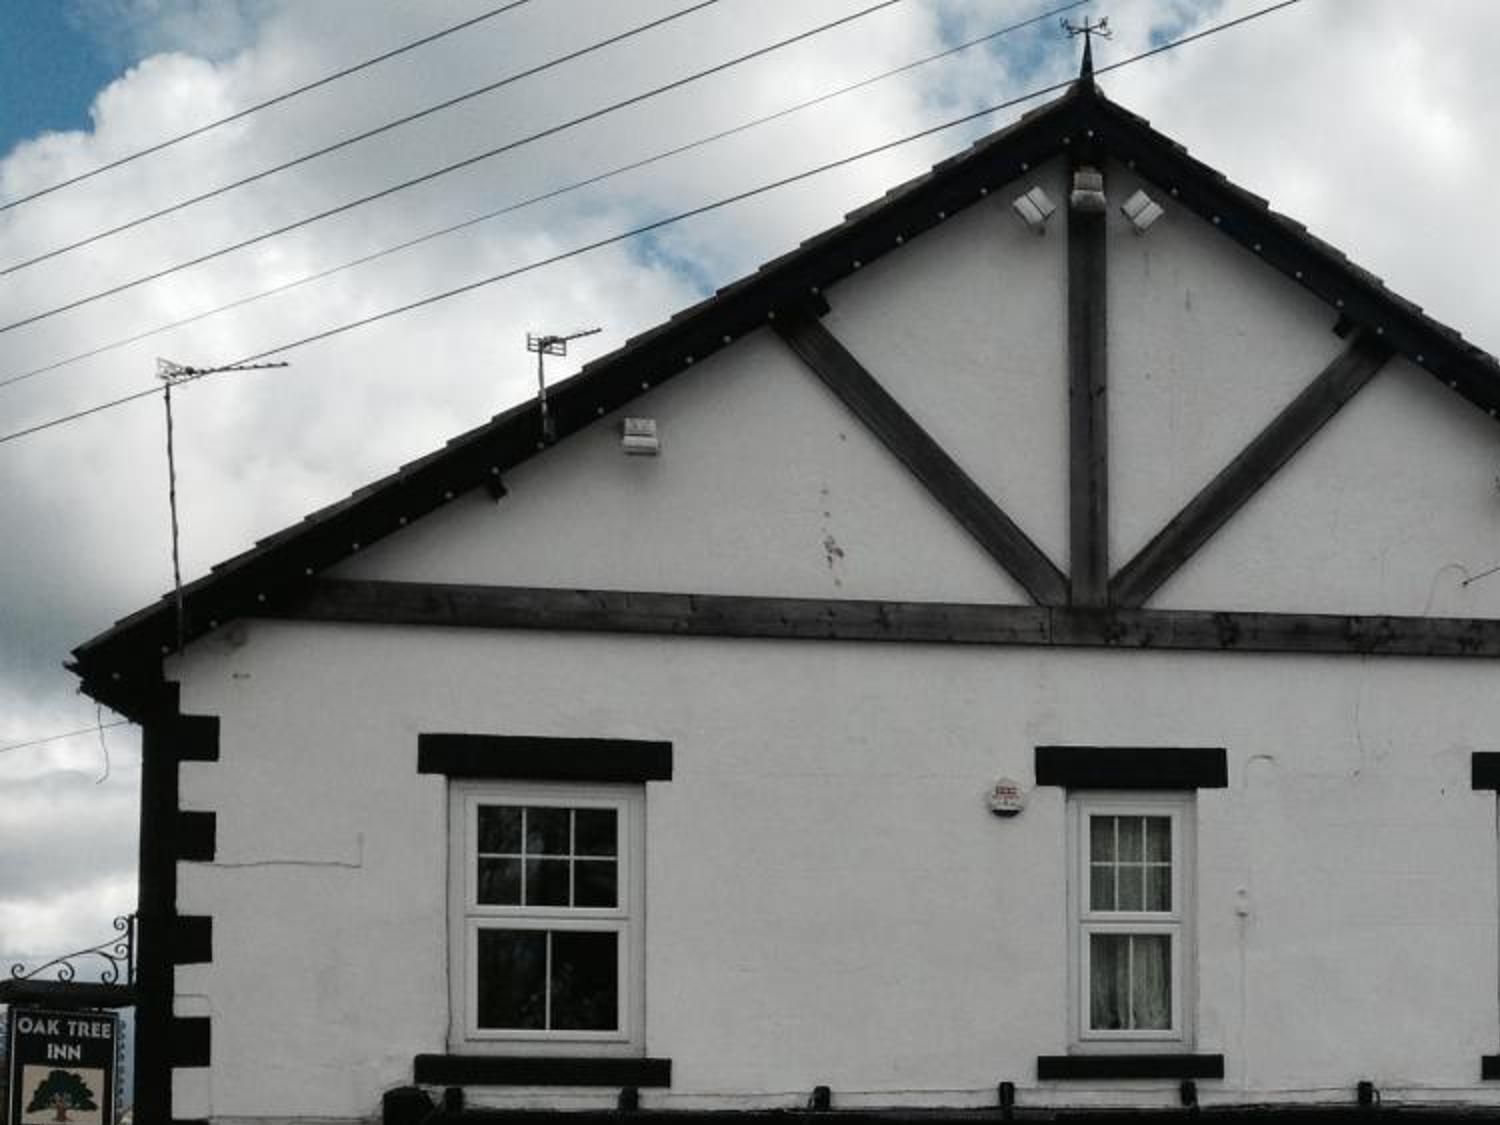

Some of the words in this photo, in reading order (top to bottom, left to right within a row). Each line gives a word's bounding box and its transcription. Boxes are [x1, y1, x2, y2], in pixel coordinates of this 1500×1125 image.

[17, 1017, 60, 1036] OAK
[67, 1020, 112, 1039] TREE
[47, 1043, 81, 1061] INN
